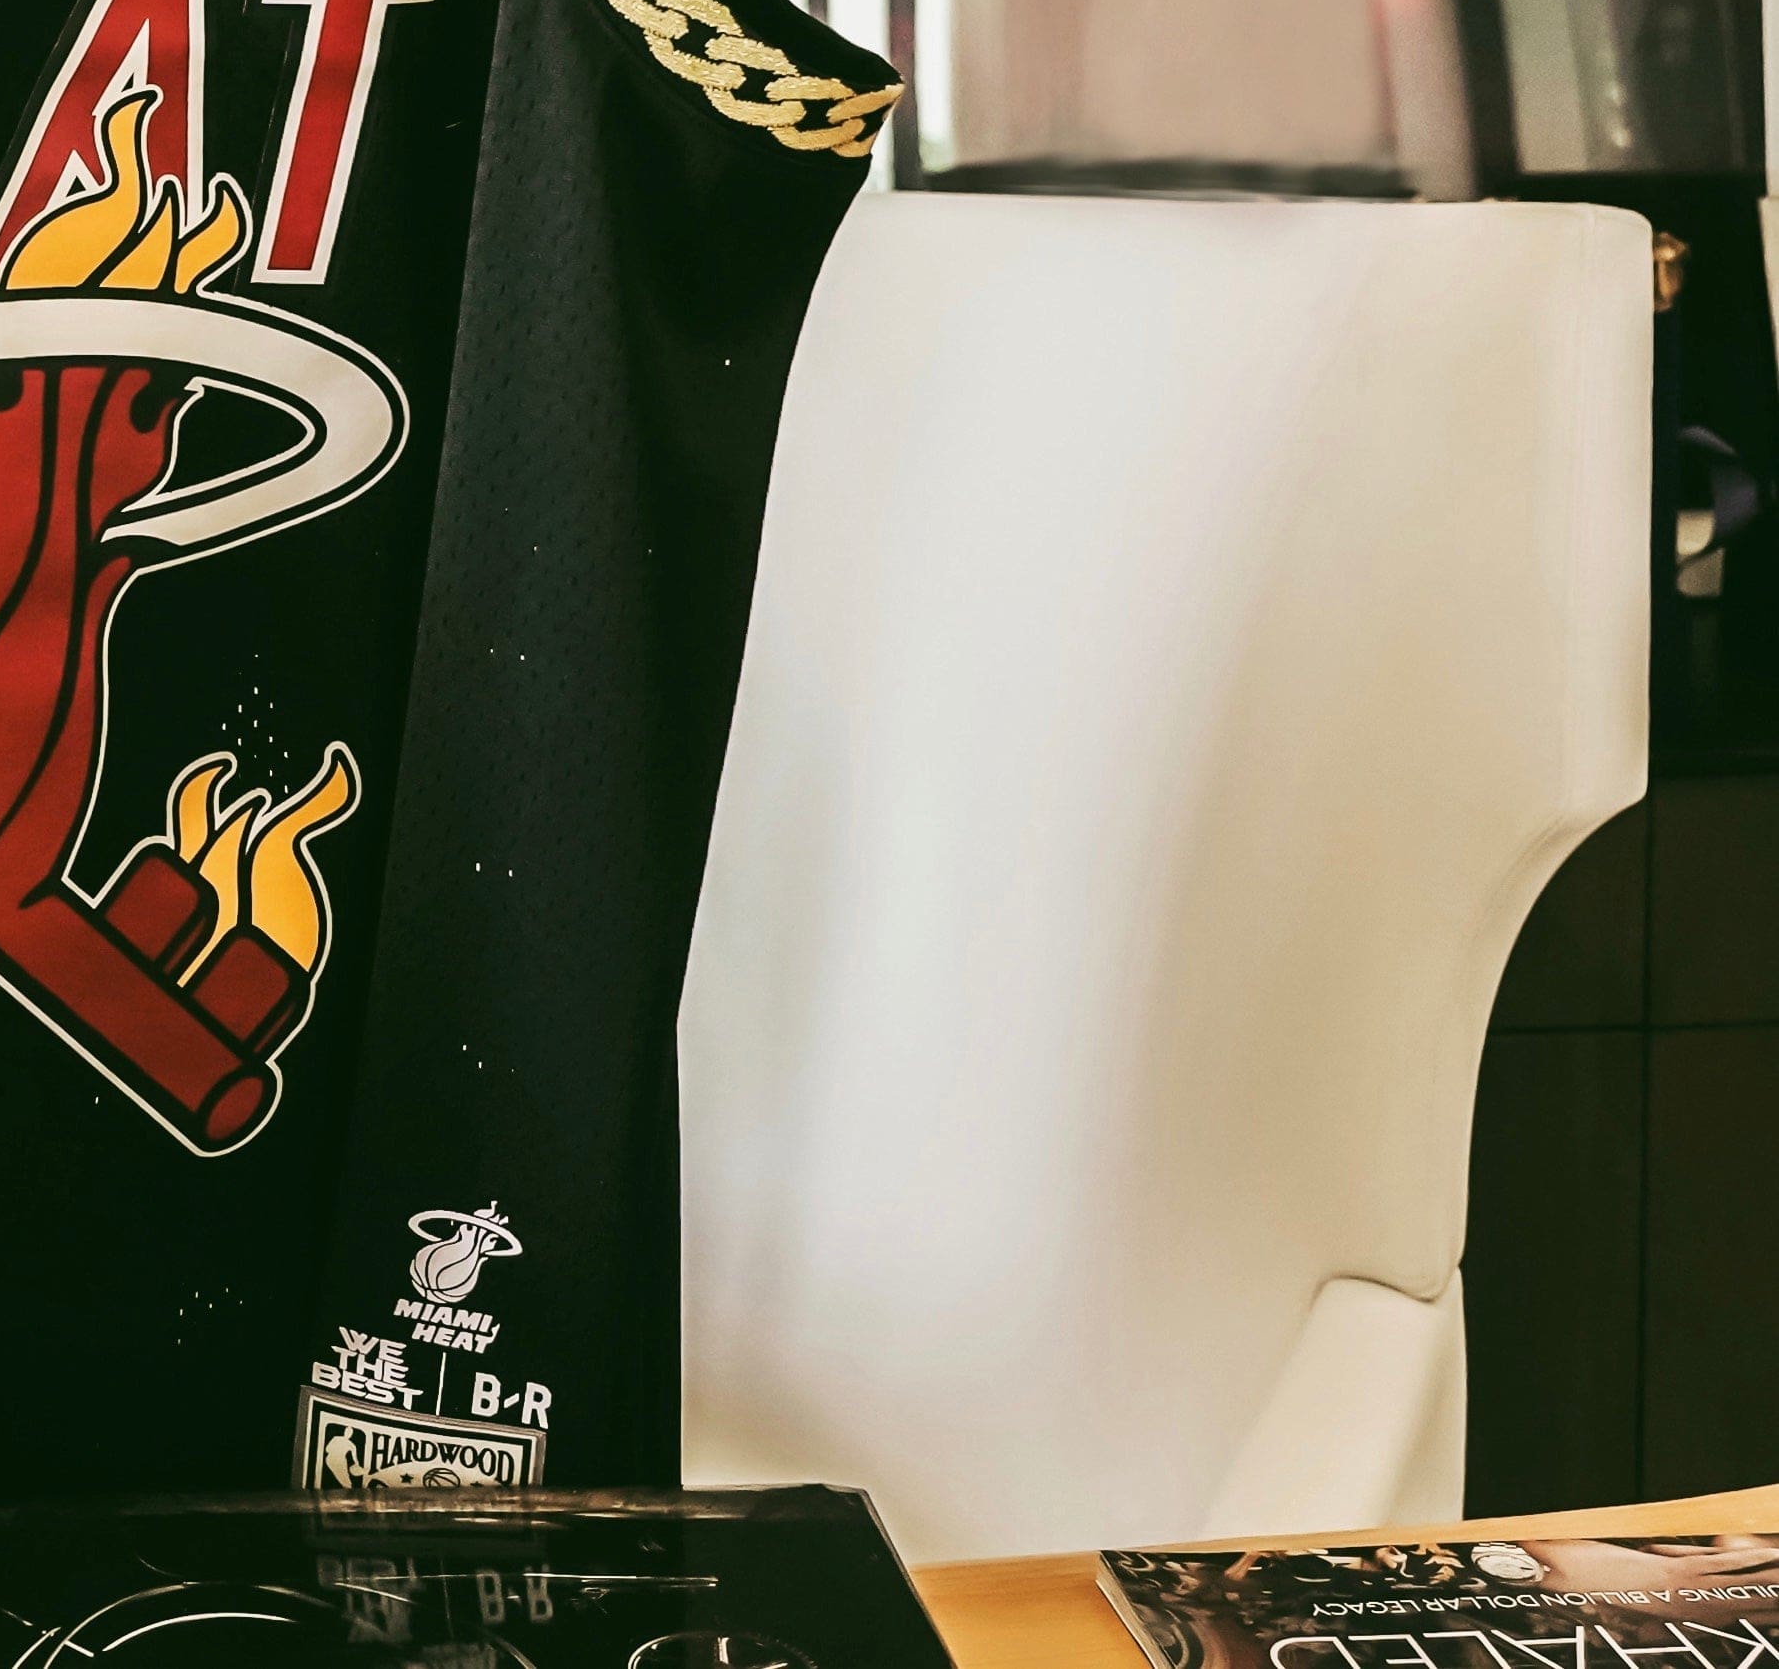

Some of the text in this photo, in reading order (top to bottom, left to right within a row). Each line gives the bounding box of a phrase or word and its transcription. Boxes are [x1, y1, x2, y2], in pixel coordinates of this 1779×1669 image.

[393, 1298, 494, 1332] MIAMI
[338, 1325, 408, 1365] WE
[411, 1322, 501, 1354] HEAT
[330, 1344, 409, 1388] THE
[311, 1361, 424, 1411] BEST
[371, 1431, 515, 1486] HARDWOOD
[1312, 1598, 1422, 1617] LEGACY
[1422, 1593, 1541, 1612] DOLLAR
[1539, 1589, 1652, 1607] BILLION
[1651, 1589, 1671, 1603] A
[1270, 1618, 1779, 1669] KHALED
